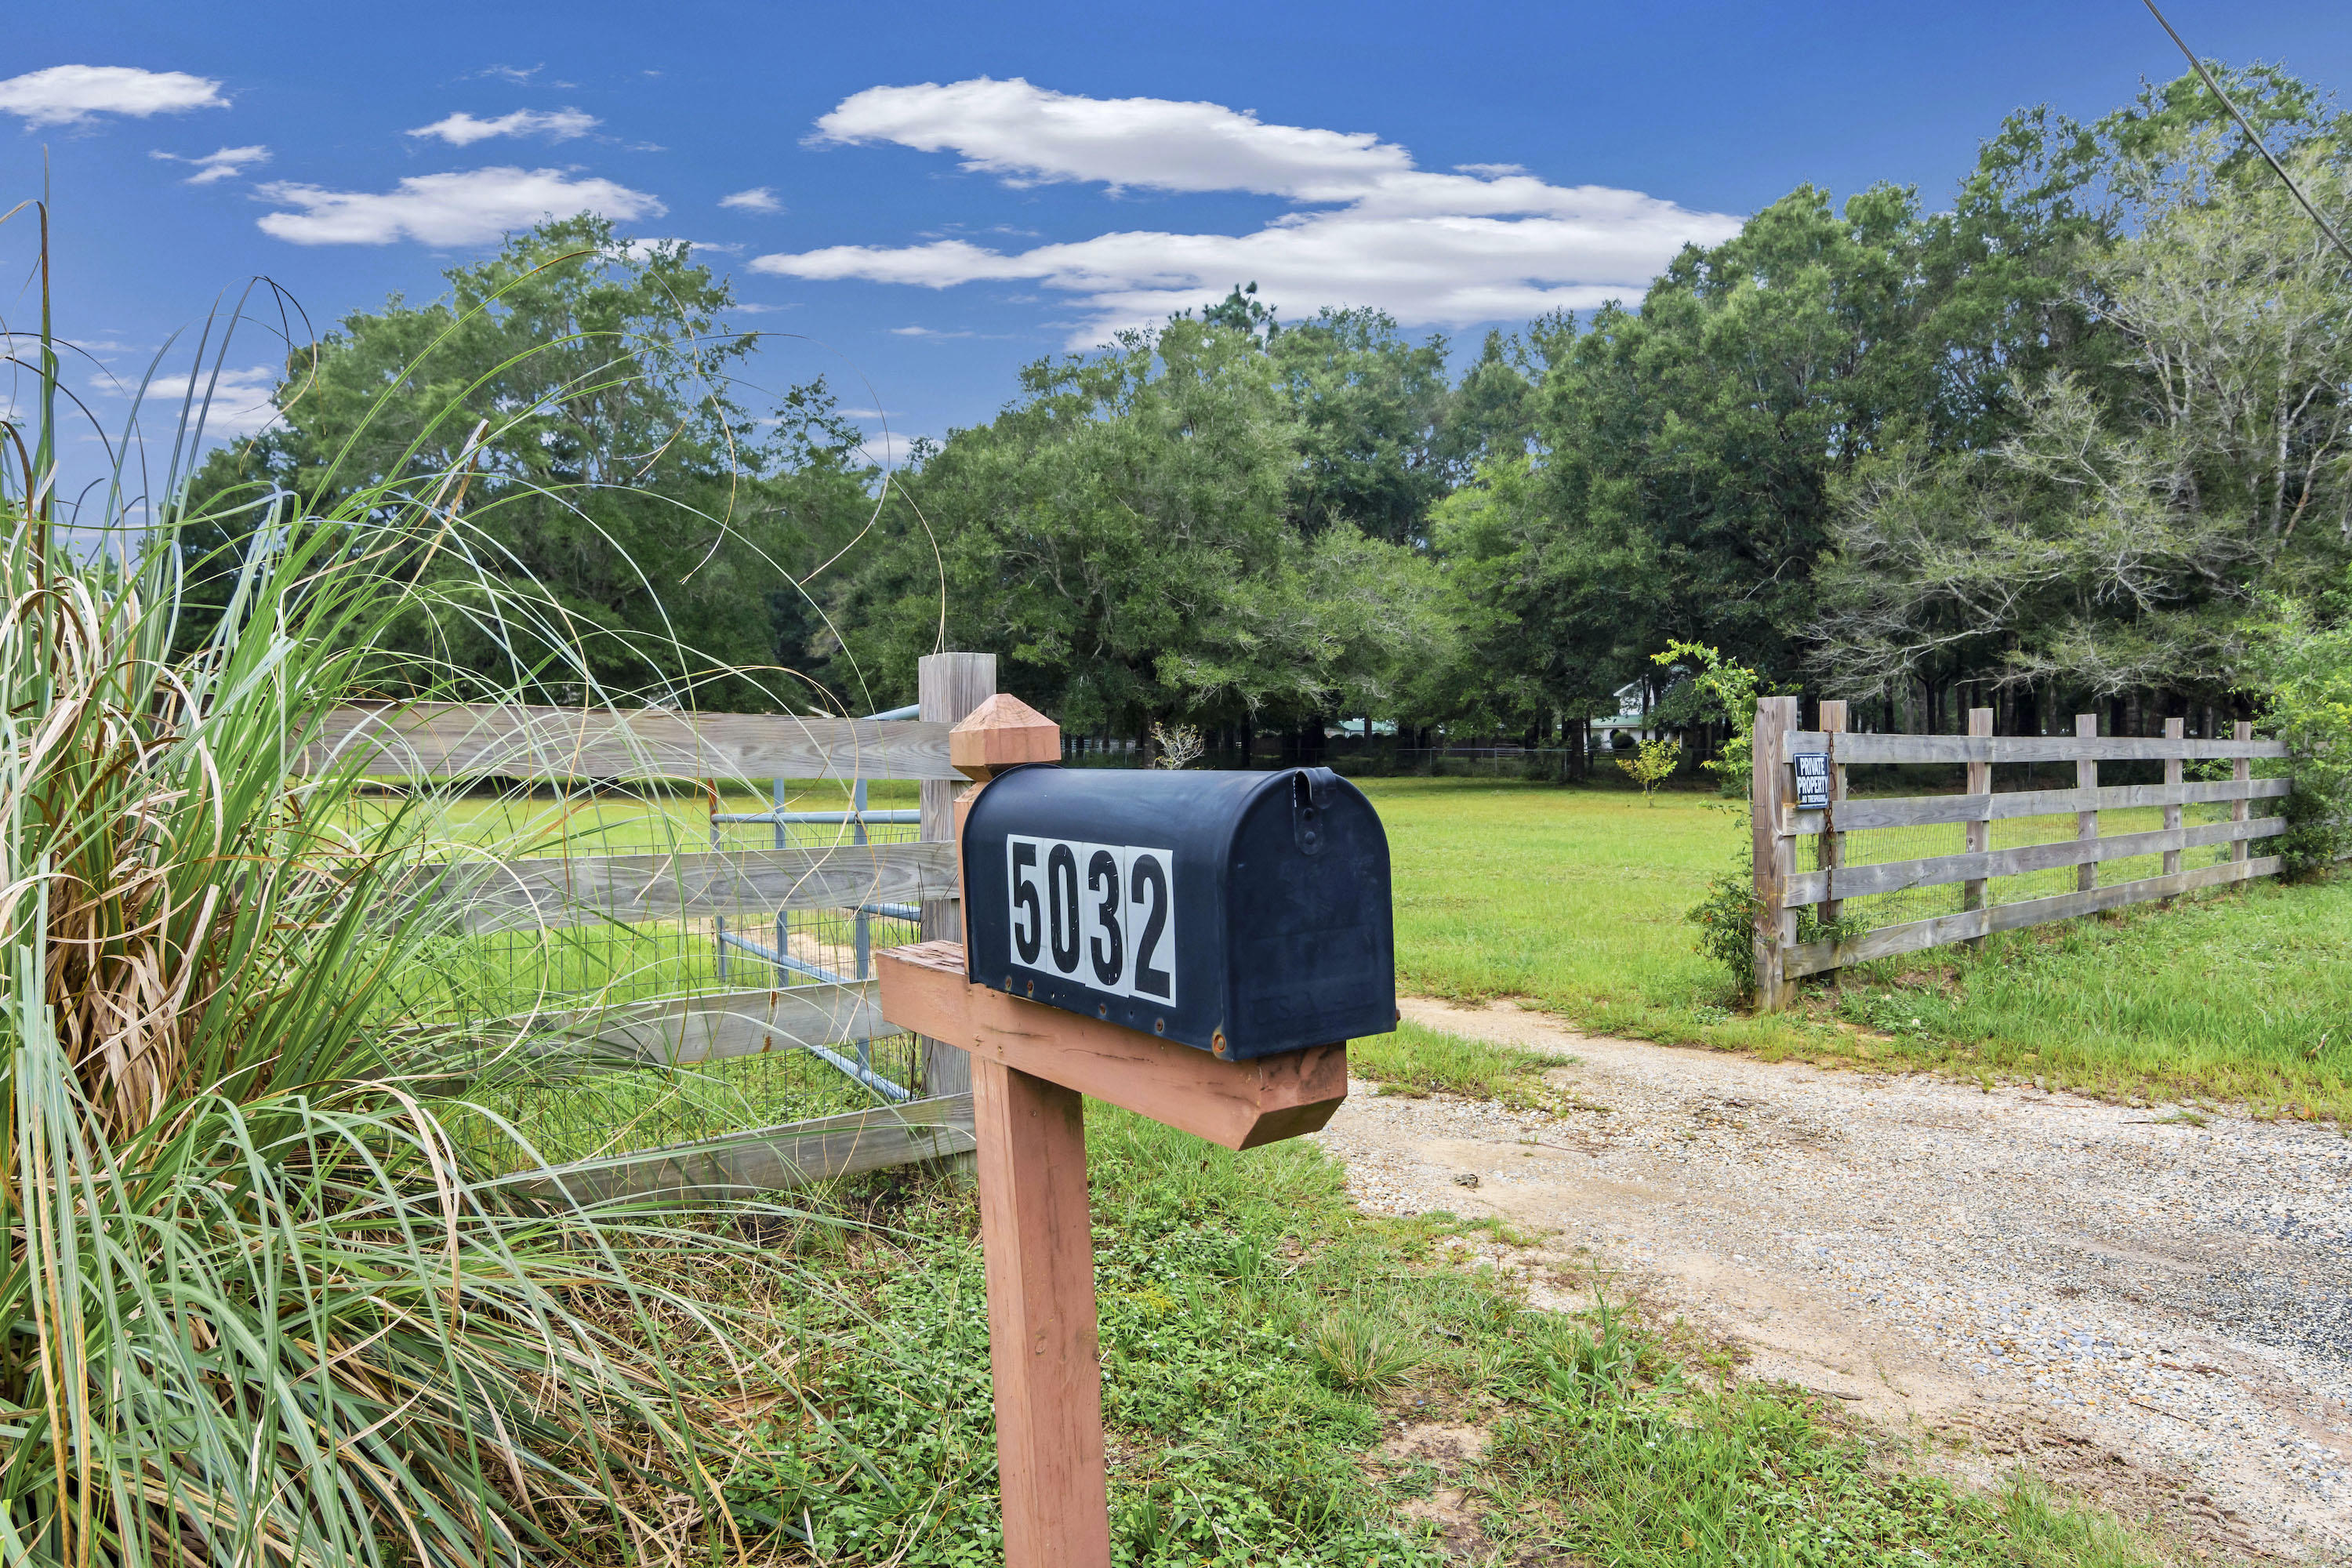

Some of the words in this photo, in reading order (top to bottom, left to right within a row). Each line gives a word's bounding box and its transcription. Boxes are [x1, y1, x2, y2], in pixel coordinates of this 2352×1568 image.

[1800, 757, 1825, 775] PRIVATE
[1797, 776, 1828, 793] PROPERTY
[1012, 841, 1171, 1000] 5032
